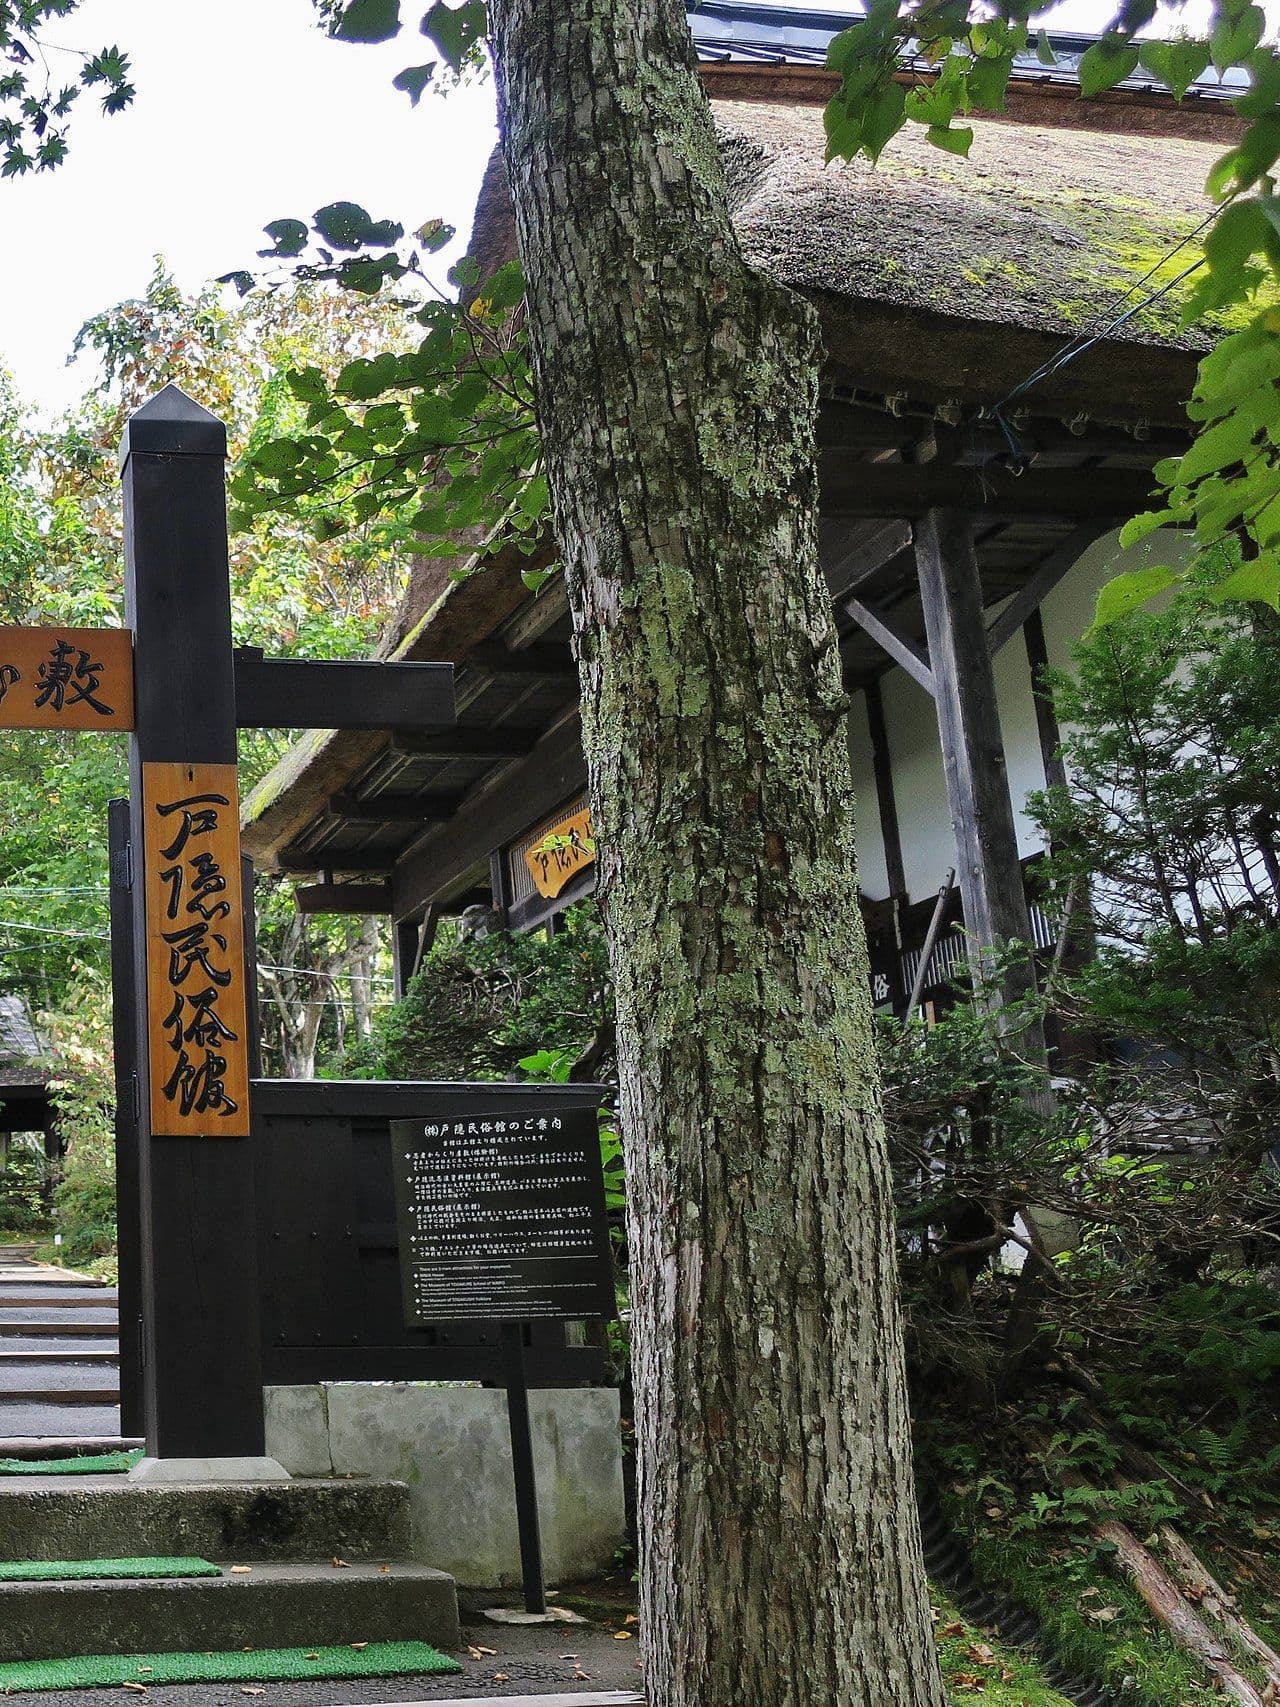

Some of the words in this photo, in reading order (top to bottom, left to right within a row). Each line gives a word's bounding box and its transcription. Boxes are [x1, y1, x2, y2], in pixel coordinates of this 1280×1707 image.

[155, 793, 239, 1117] 戸隠民俗館
